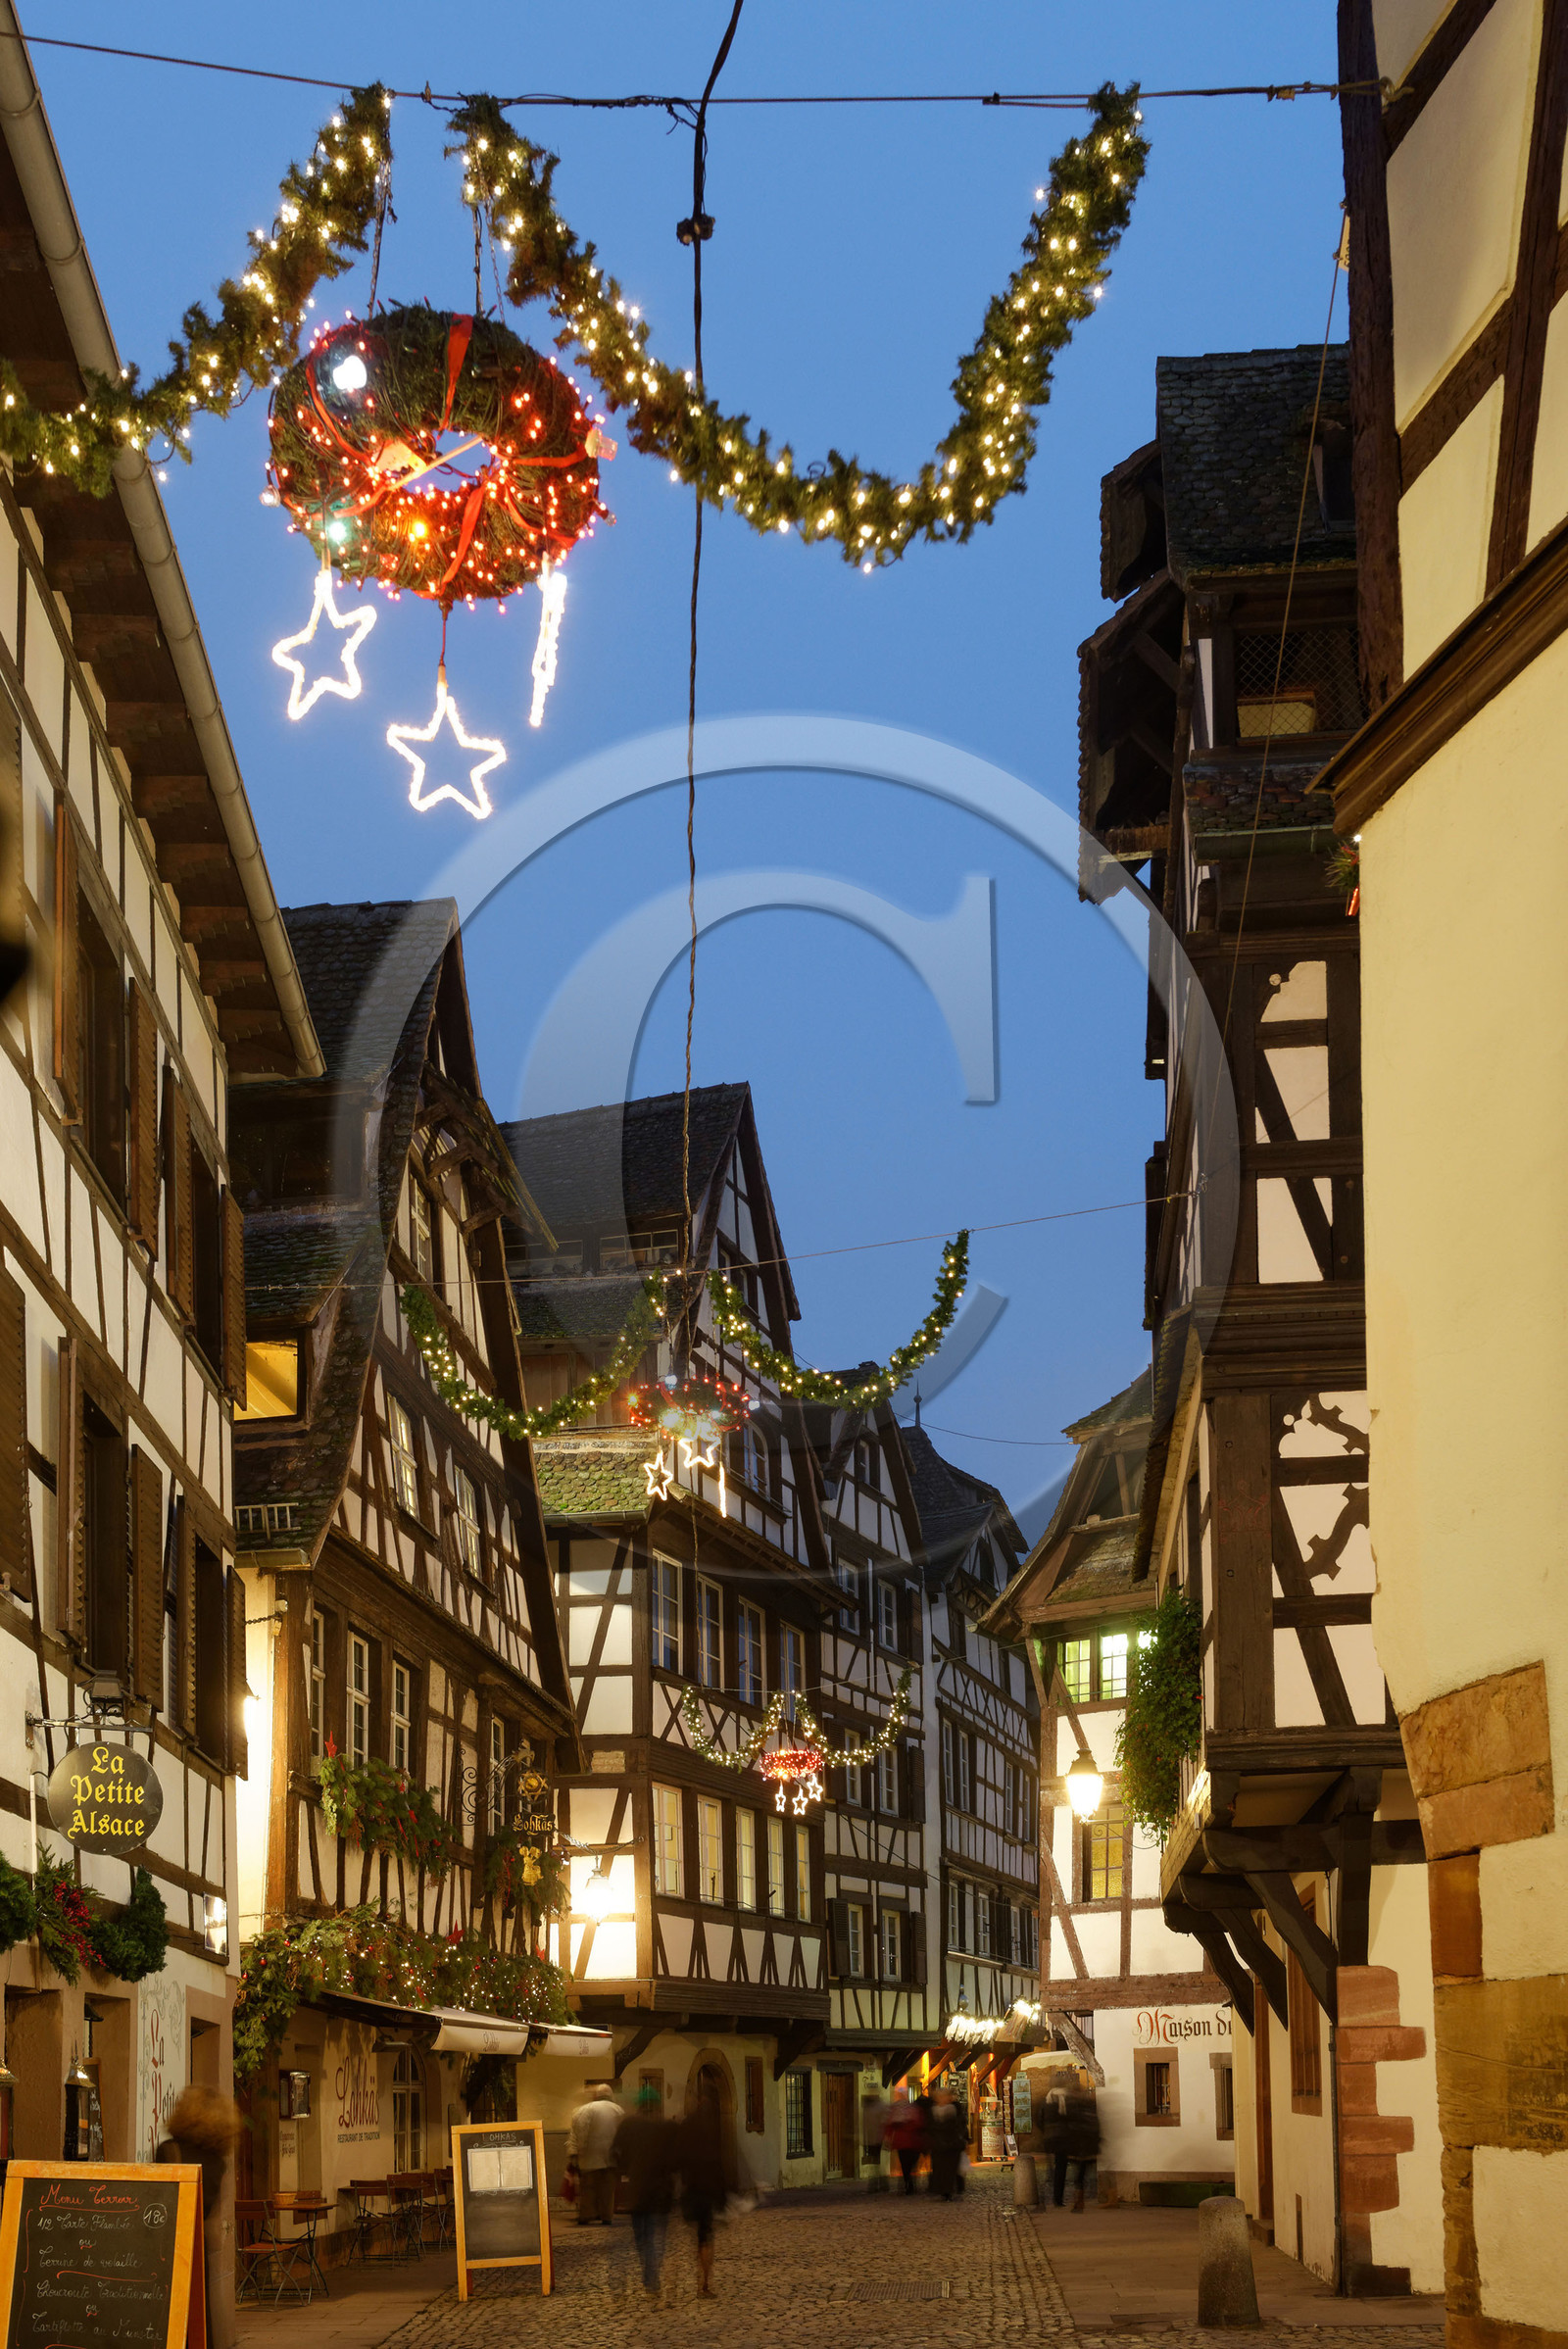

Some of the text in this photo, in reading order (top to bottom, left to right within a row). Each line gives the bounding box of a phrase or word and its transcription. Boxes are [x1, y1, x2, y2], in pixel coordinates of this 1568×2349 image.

[90, 1746, 125, 1775] La
[71, 1775, 145, 1807] Petite
[68, 1809, 145, 1839] Alsace
[1133, 2008, 1232, 2046] Maison d
[335, 2056, 380, 2129] Lohkäs
[40, 2183, 84, 2205] Menu
[57, 2213, 89, 2230] Tarte
[83, 2254, 95, 2268] de
